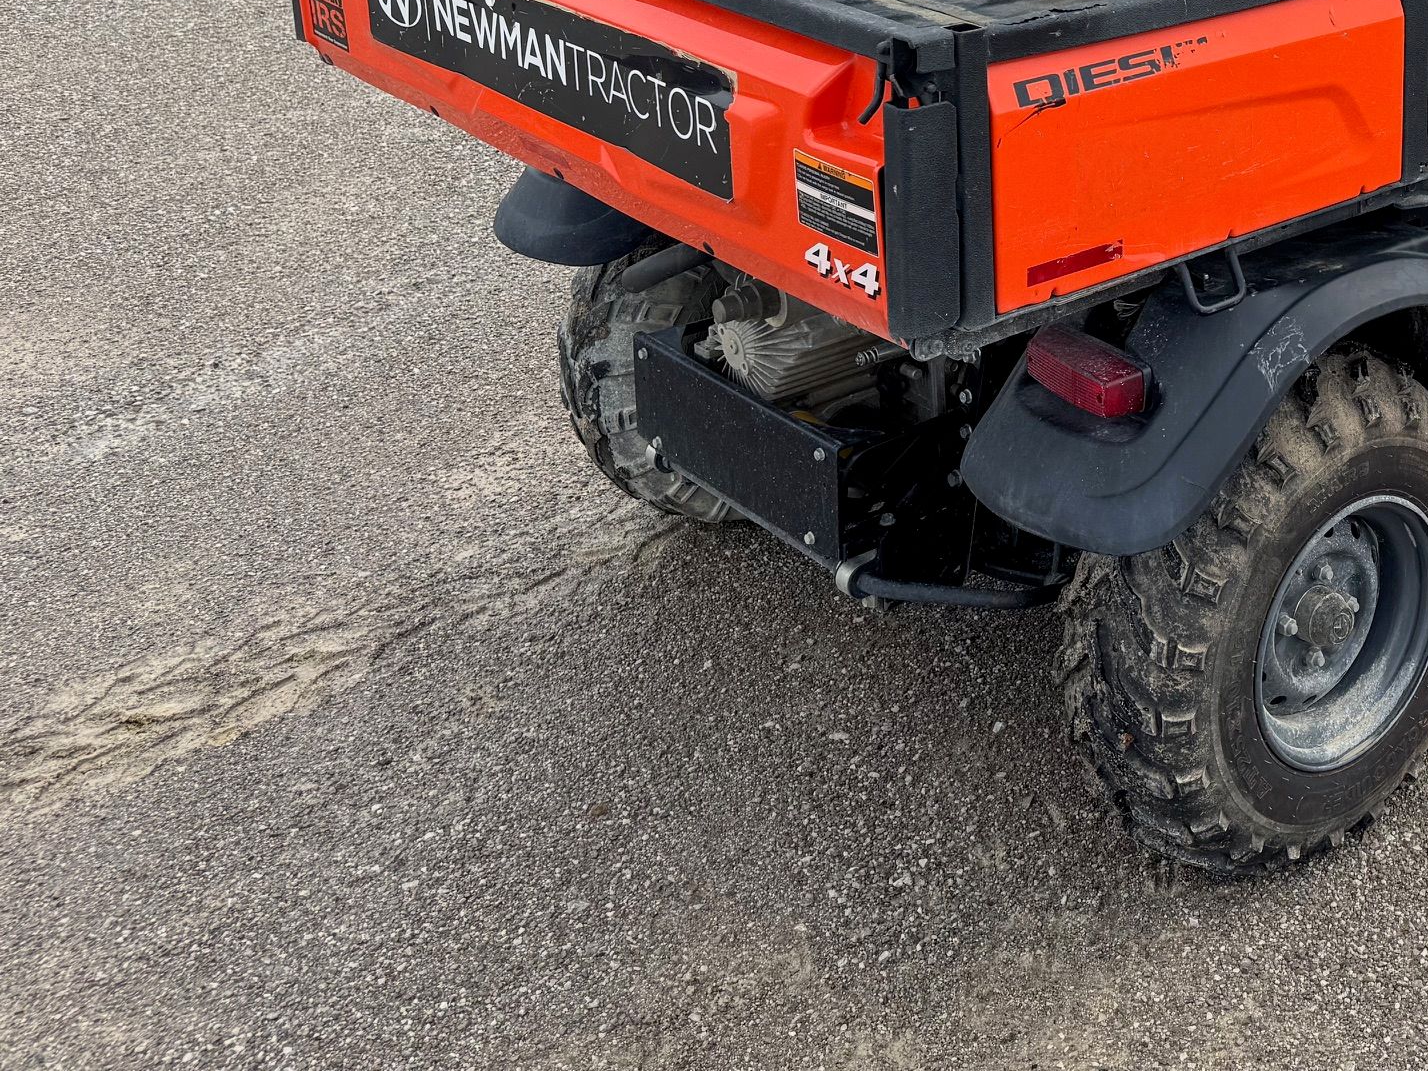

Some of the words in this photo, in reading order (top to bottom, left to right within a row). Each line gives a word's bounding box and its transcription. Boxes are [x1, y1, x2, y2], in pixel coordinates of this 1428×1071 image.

[822, 163, 847, 180] WARNING
[819, 193, 848, 210] IMPORTANT
[804, 242, 881, 299] 4x4
